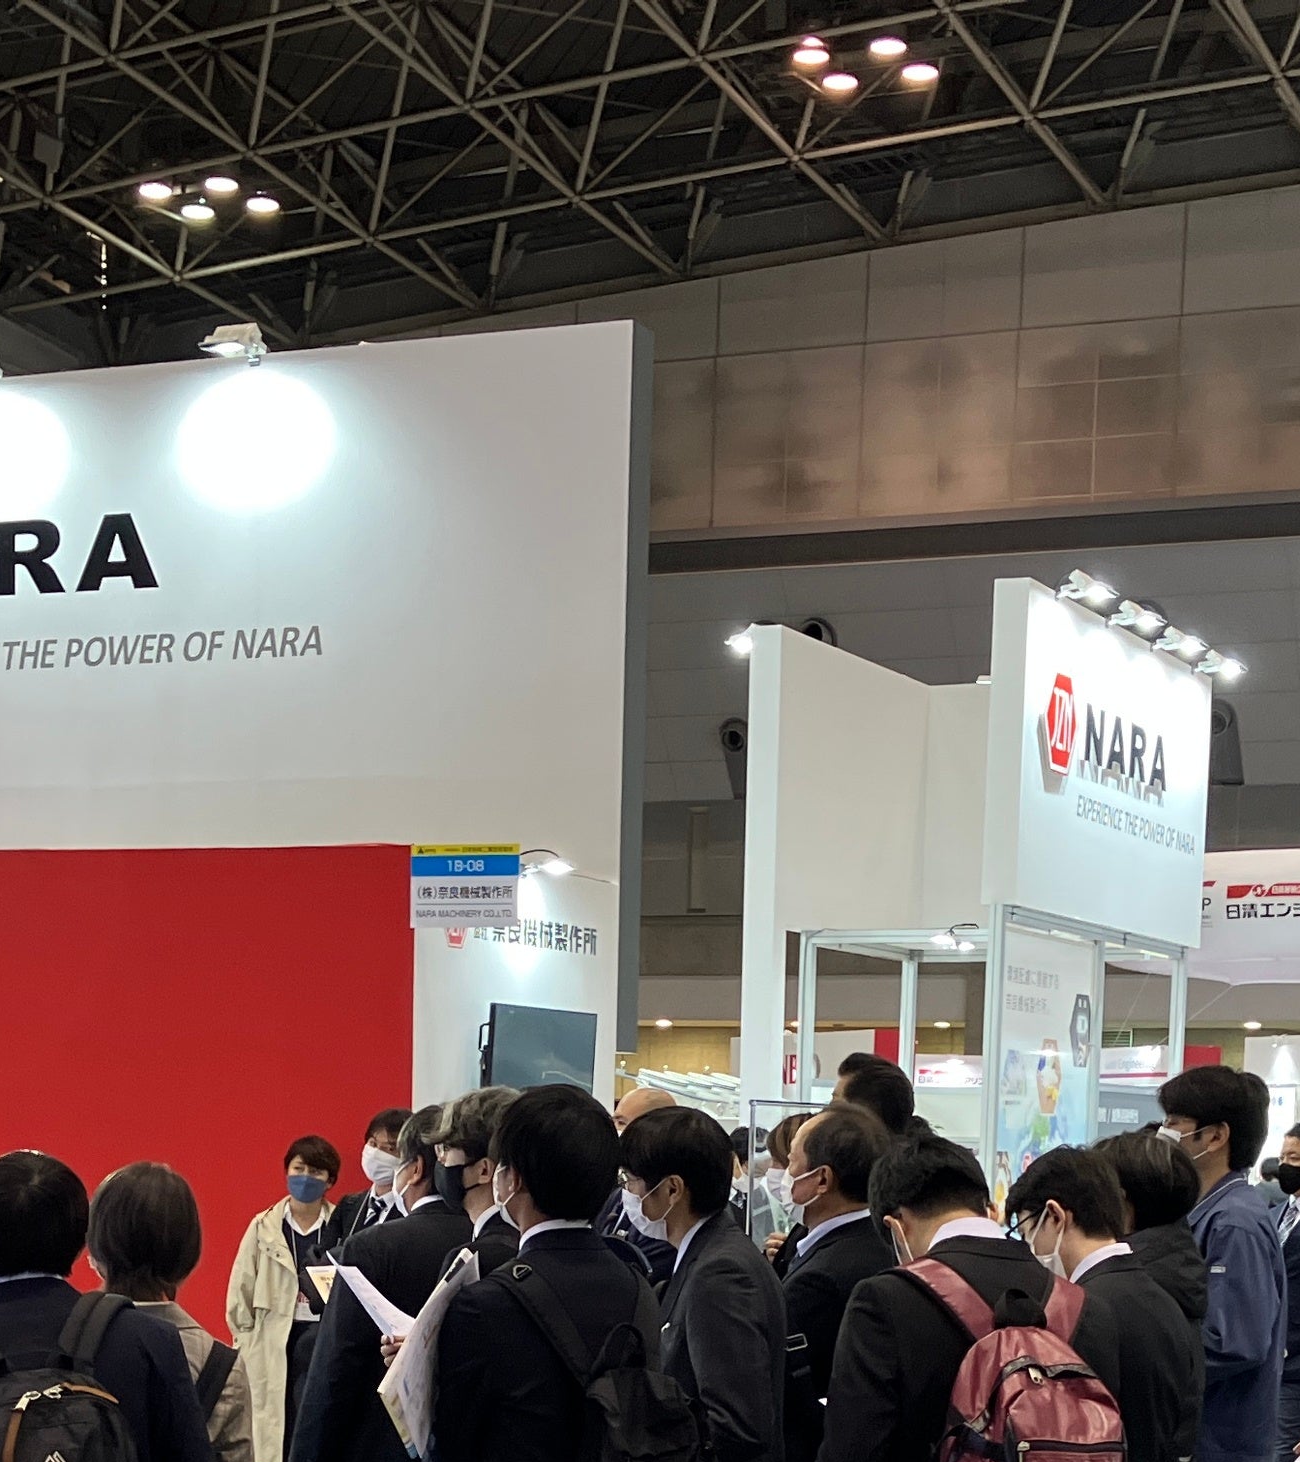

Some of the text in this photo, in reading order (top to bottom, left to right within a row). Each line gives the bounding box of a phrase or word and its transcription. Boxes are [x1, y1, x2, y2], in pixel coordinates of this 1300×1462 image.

[3, 638, 57, 671] THE
[64, 633, 175, 668] POWER
[182, 630, 226, 661] OF
[232, 625, 324, 658] NARA
[1084, 703, 1167, 792] NARA
[1076, 795, 1195, 856] EXPERIENCE THE POWER OF NARA
[447, 859, 485, 872] 1B-08
